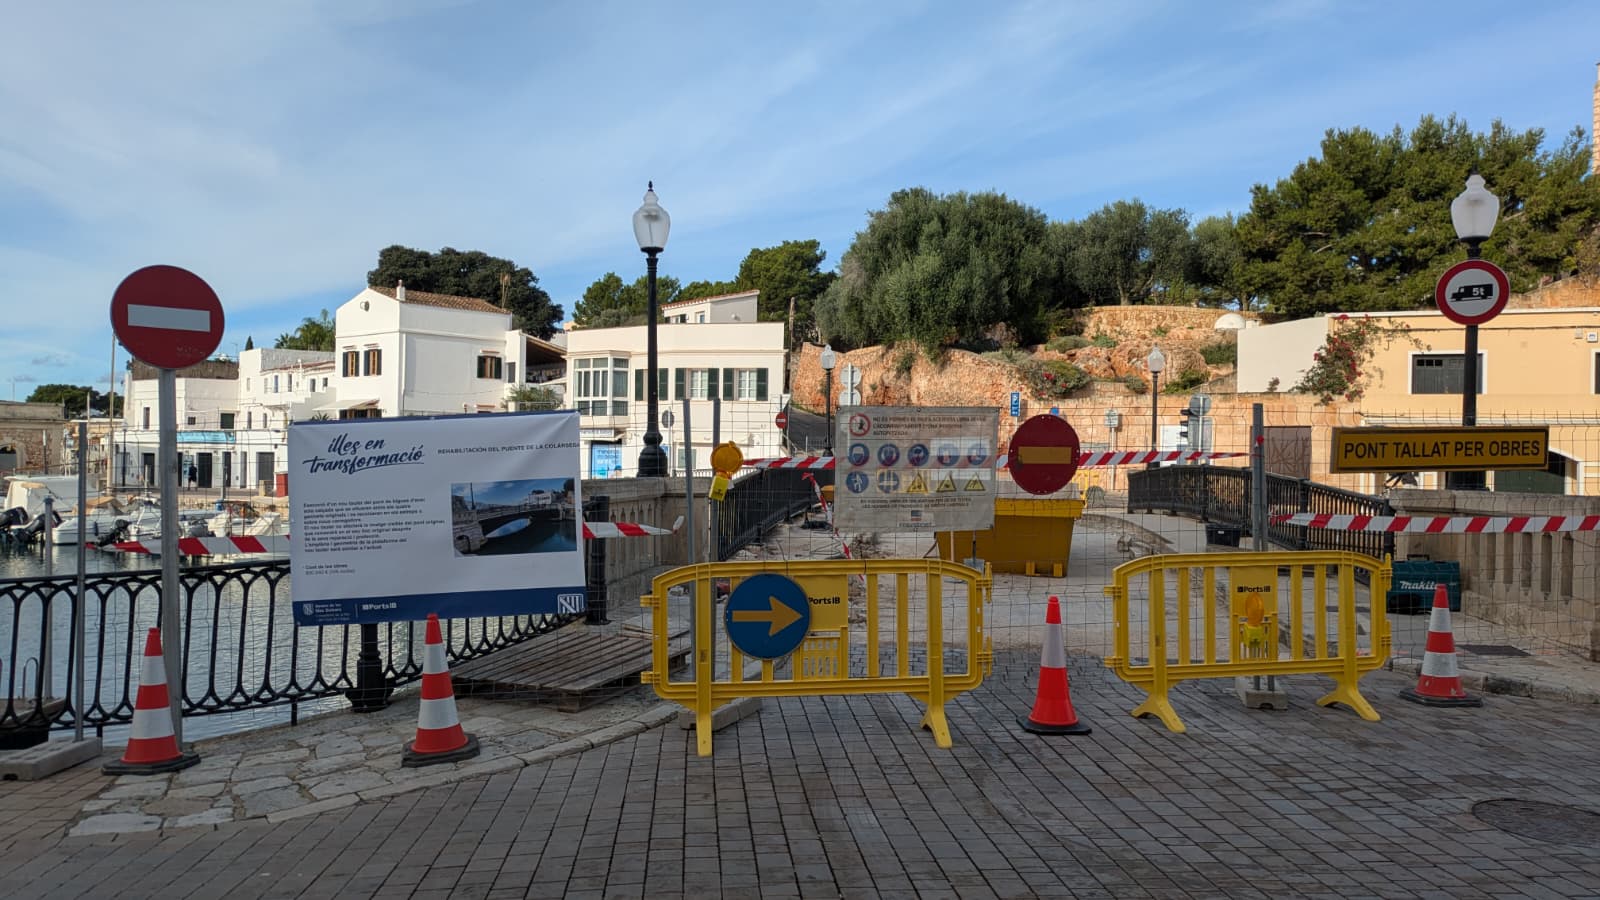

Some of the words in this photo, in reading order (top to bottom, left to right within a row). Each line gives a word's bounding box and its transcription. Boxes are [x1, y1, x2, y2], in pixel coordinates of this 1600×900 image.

[1472, 287, 1485, 296] 5t
[328, 433, 360, 456] illes
[365, 439, 385, 450] en
[1344, 442, 1388, 459] PONT
[1393, 441, 1450, 458] TALLAT
[1454, 440, 1484, 457] PER
[1488, 439, 1540, 456] OBRES
[302, 445, 425, 475] transformació
